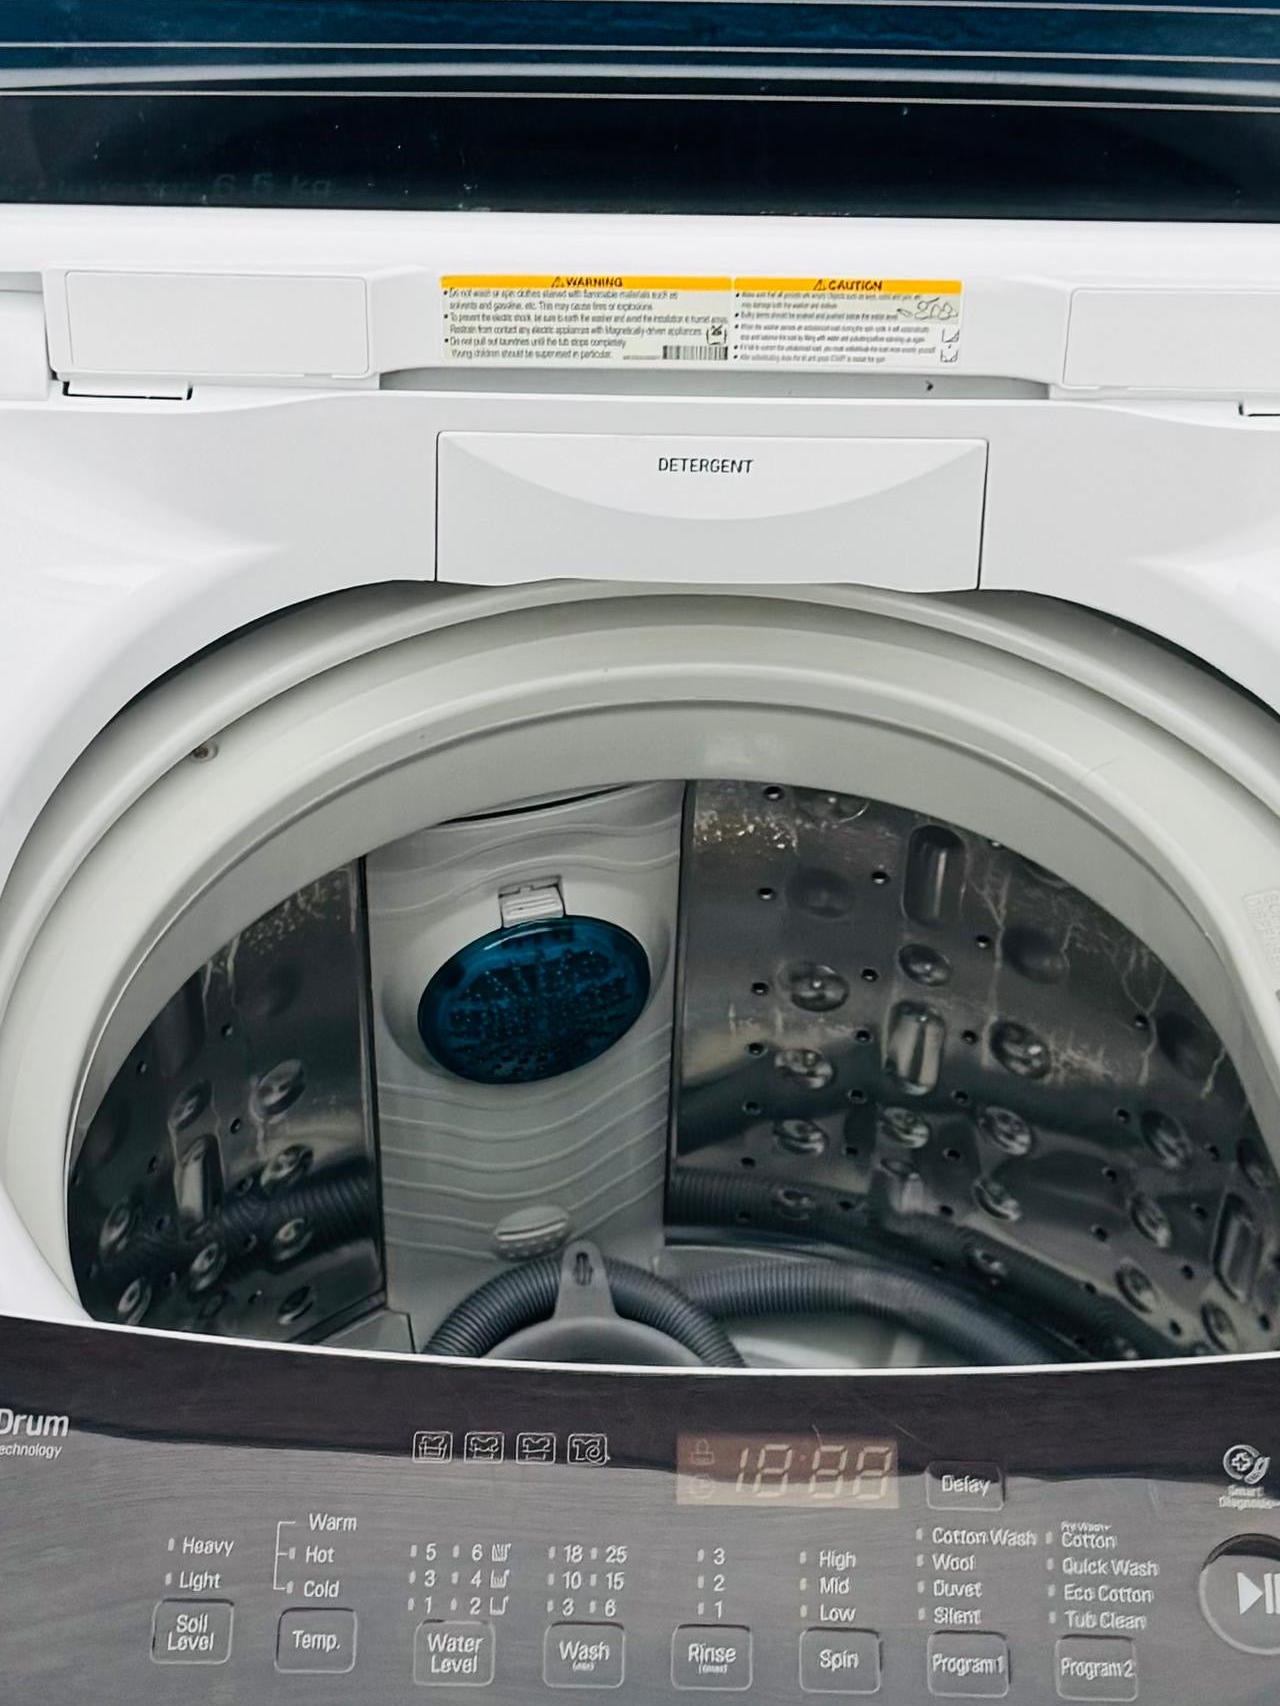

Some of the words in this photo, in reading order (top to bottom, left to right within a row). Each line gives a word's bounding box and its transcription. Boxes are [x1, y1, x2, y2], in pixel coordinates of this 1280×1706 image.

[566, 277, 623, 288] WARNING
[828, 279, 883, 291] CAUTION
[658, 457, 753, 473] DETERGENT
[941, 1474, 991, 1497] Delay
[309, 1514, 357, 1532] Warm
[182, 1537, 234, 1556] Heavy
[932, 1527, 988, 1546] Cotton
[990, 1529, 1037, 1547] Wash
[1062, 1532, 1118, 1549] Cotton
[305, 1545, 335, 1564] Hot
[426, 1543, 436, 1561] 5
[471, 1544, 482, 1561] 6
[563, 1544, 584, 1563] 18
[606, 1546, 628, 1564] 25
[712, 1548, 725, 1565] 3
[819, 1550, 856, 1571] High
[932, 1554, 976, 1571] Wool
[1062, 1557, 1109, 1576] Quick
[1110, 1559, 1160, 1577] Wash
[179, 1571, 221, 1590] Light
[424, 1570, 436, 1587] 3
[471, 1571, 481, 1588] 4
[562, 1572, 582, 1590] 10
[606, 1572, 624, 1591] 15
[713, 1574, 726, 1592] 2
[819, 1577, 850, 1595] Mid
[304, 1581, 339, 1598] Cold
[933, 1580, 983, 1598] Duvet
[1064, 1583, 1096, 1601] Eco
[1098, 1585, 1154, 1604] Cotton
[425, 1597, 432, 1614] 1
[470, 1597, 481, 1615] 2
[562, 1599, 574, 1616] 3
[604, 1599, 616, 1617] 6
[714, 1602, 723, 1619] 1
[819, 1604, 856, 1622] Low
[176, 1614, 208, 1633] Soil
[934, 1607, 982, 1625] Silent
[1066, 1610, 1098, 1628] Tub
[1100, 1611, 1147, 1631] Clean
[168, 1632, 214, 1651] Level
[292, 1631, 341, 1652] Temp.
[428, 1633, 484, 1654] Water
[559, 1641, 610, 1661] Wash
[688, 1643, 737, 1663] Rinse
[819, 1649, 859, 1672] Spin
[431, 1655, 479, 1674] Level
[932, 1653, 996, 1676] Program
[1060, 1657, 1123, 1681] Program
